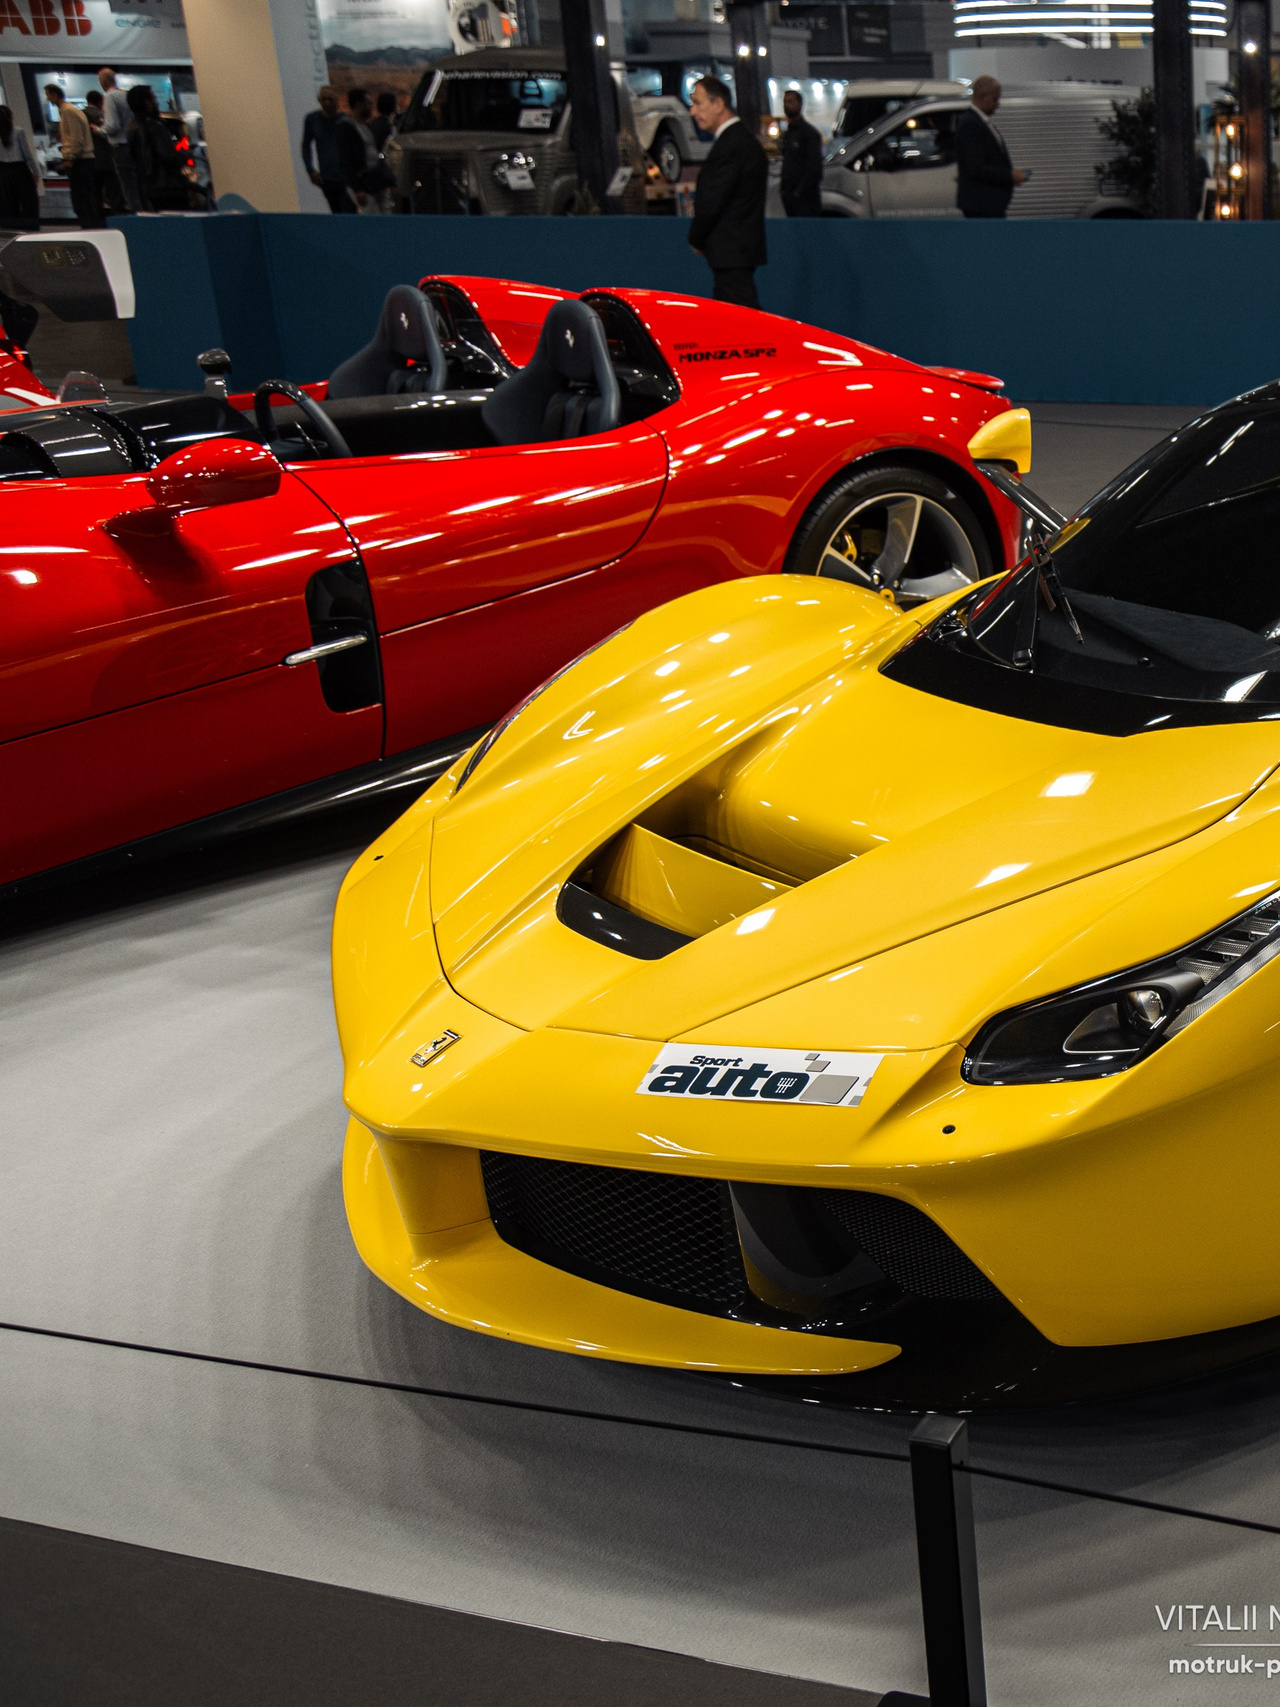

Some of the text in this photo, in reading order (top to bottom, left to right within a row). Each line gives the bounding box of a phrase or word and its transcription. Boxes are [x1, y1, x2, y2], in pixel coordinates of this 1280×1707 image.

[0, 0, 92, 36] ABB
[679, 347, 777, 362] MONZA SP2
[690, 1055, 744, 1067] Sport
[648, 1063, 810, 1100] auto
